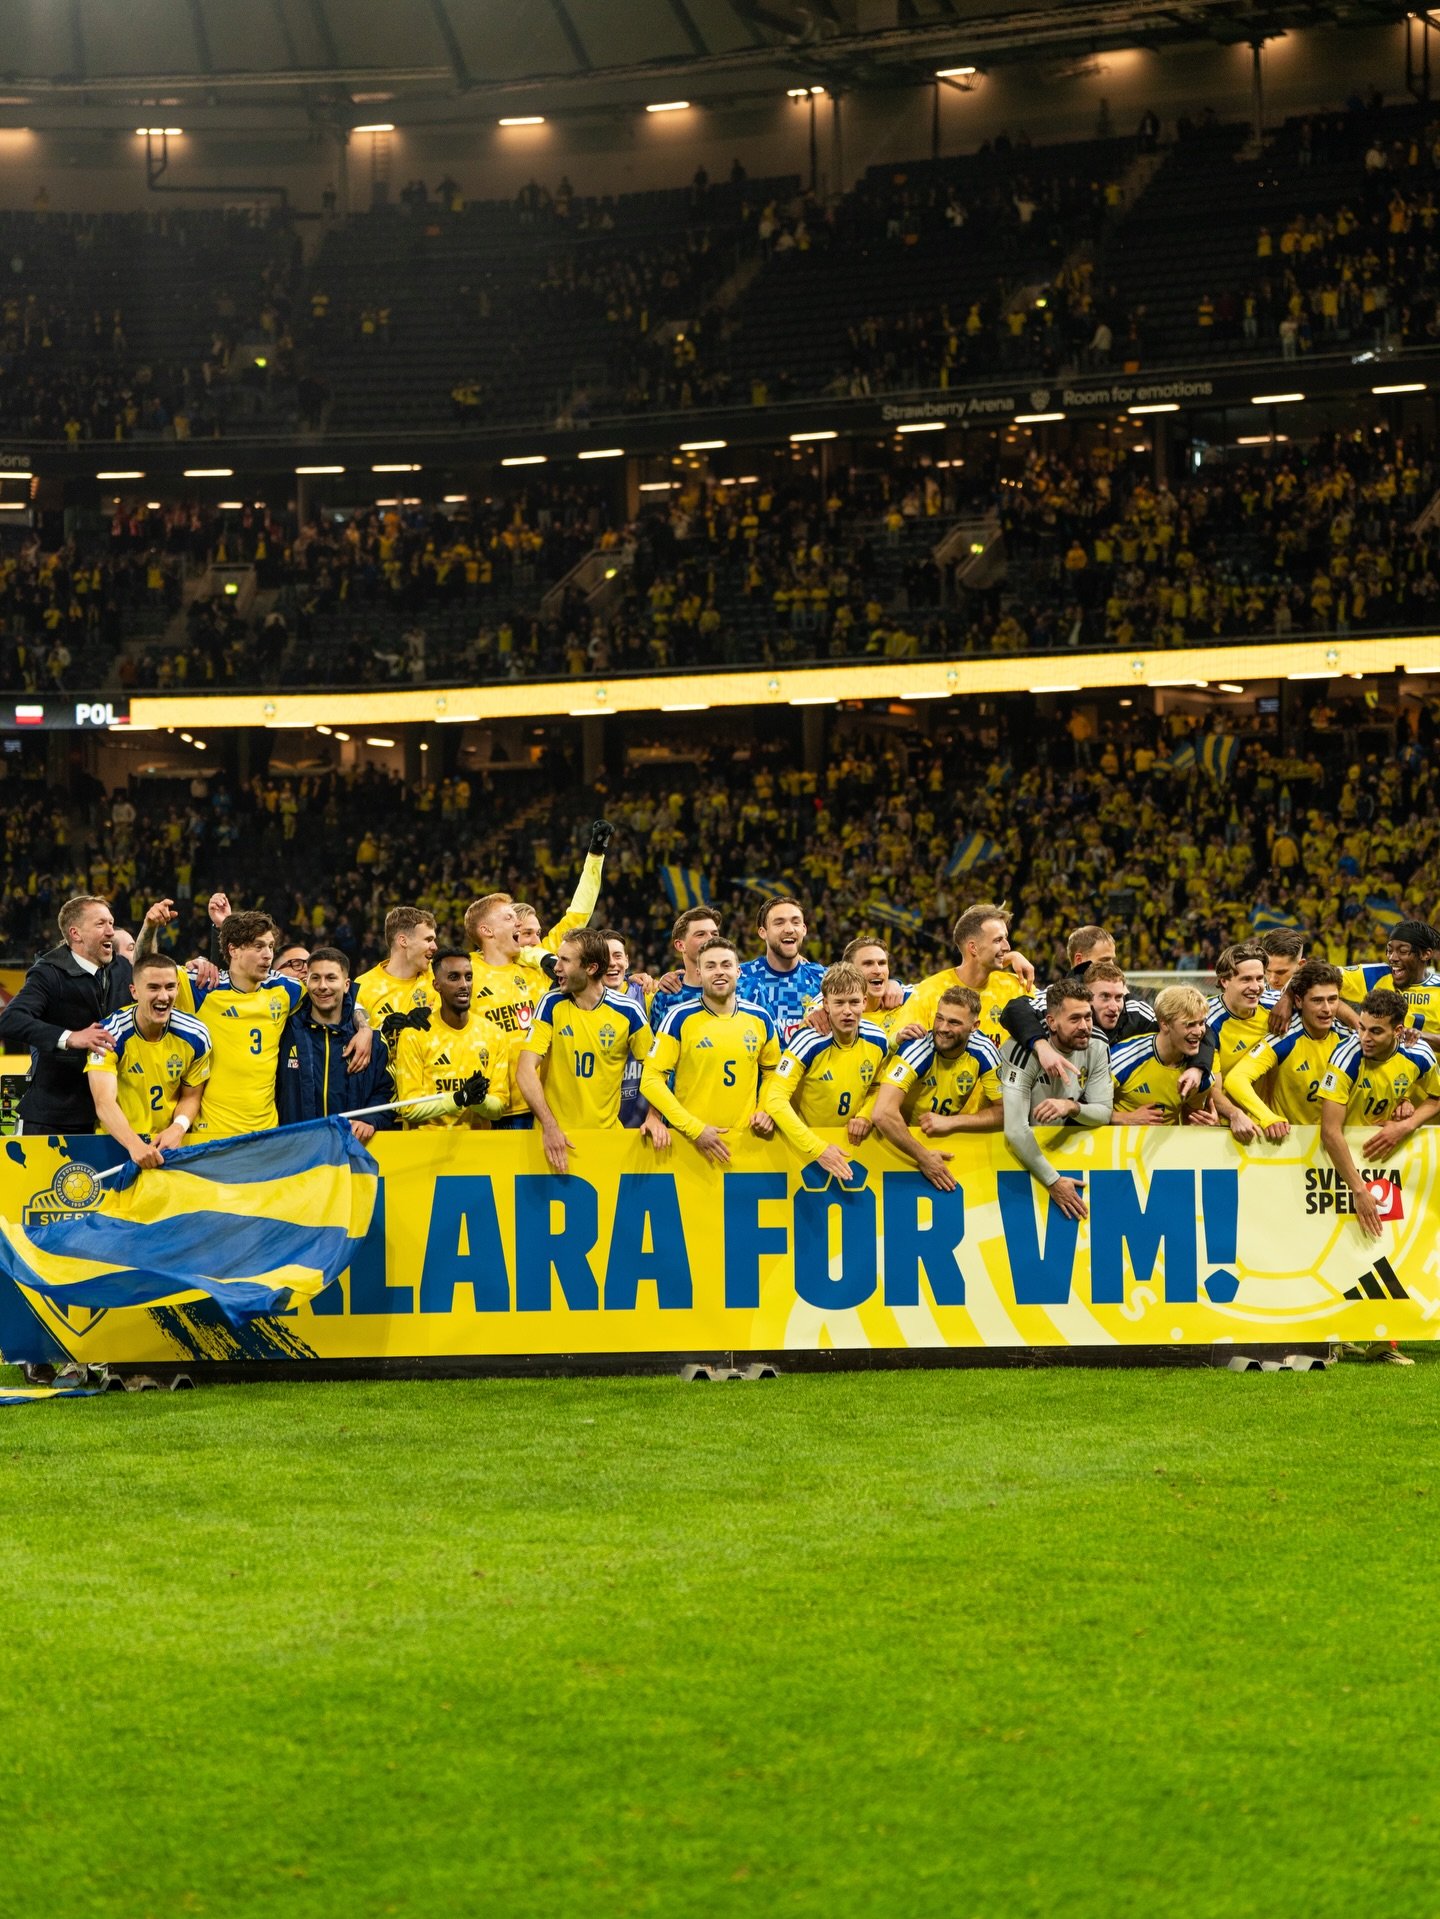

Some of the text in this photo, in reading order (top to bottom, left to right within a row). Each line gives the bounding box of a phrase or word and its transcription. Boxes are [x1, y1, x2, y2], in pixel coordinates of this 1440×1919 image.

[1062, 381, 1213, 406] Room for emotions
[881, 398, 1015, 420] Strawberry Arena
[75, 703, 119, 725] POL
[250, 1028, 262, 1055] 3
[574, 1050, 595, 1078] 10
[723, 1060, 736, 1087] 5
[435, 1077, 468, 1091] SVEN
[150, 1085, 163, 1111] 2
[837, 1091, 851, 1117] 8
[1364, 1096, 1389, 1116] 18
[1305, 1168, 1402, 1191] SVESKA
[279, 1172, 694, 1316] LARA
[723, 1159, 965, 1310] FÖR
[997, 1169, 1240, 1304] VM!
